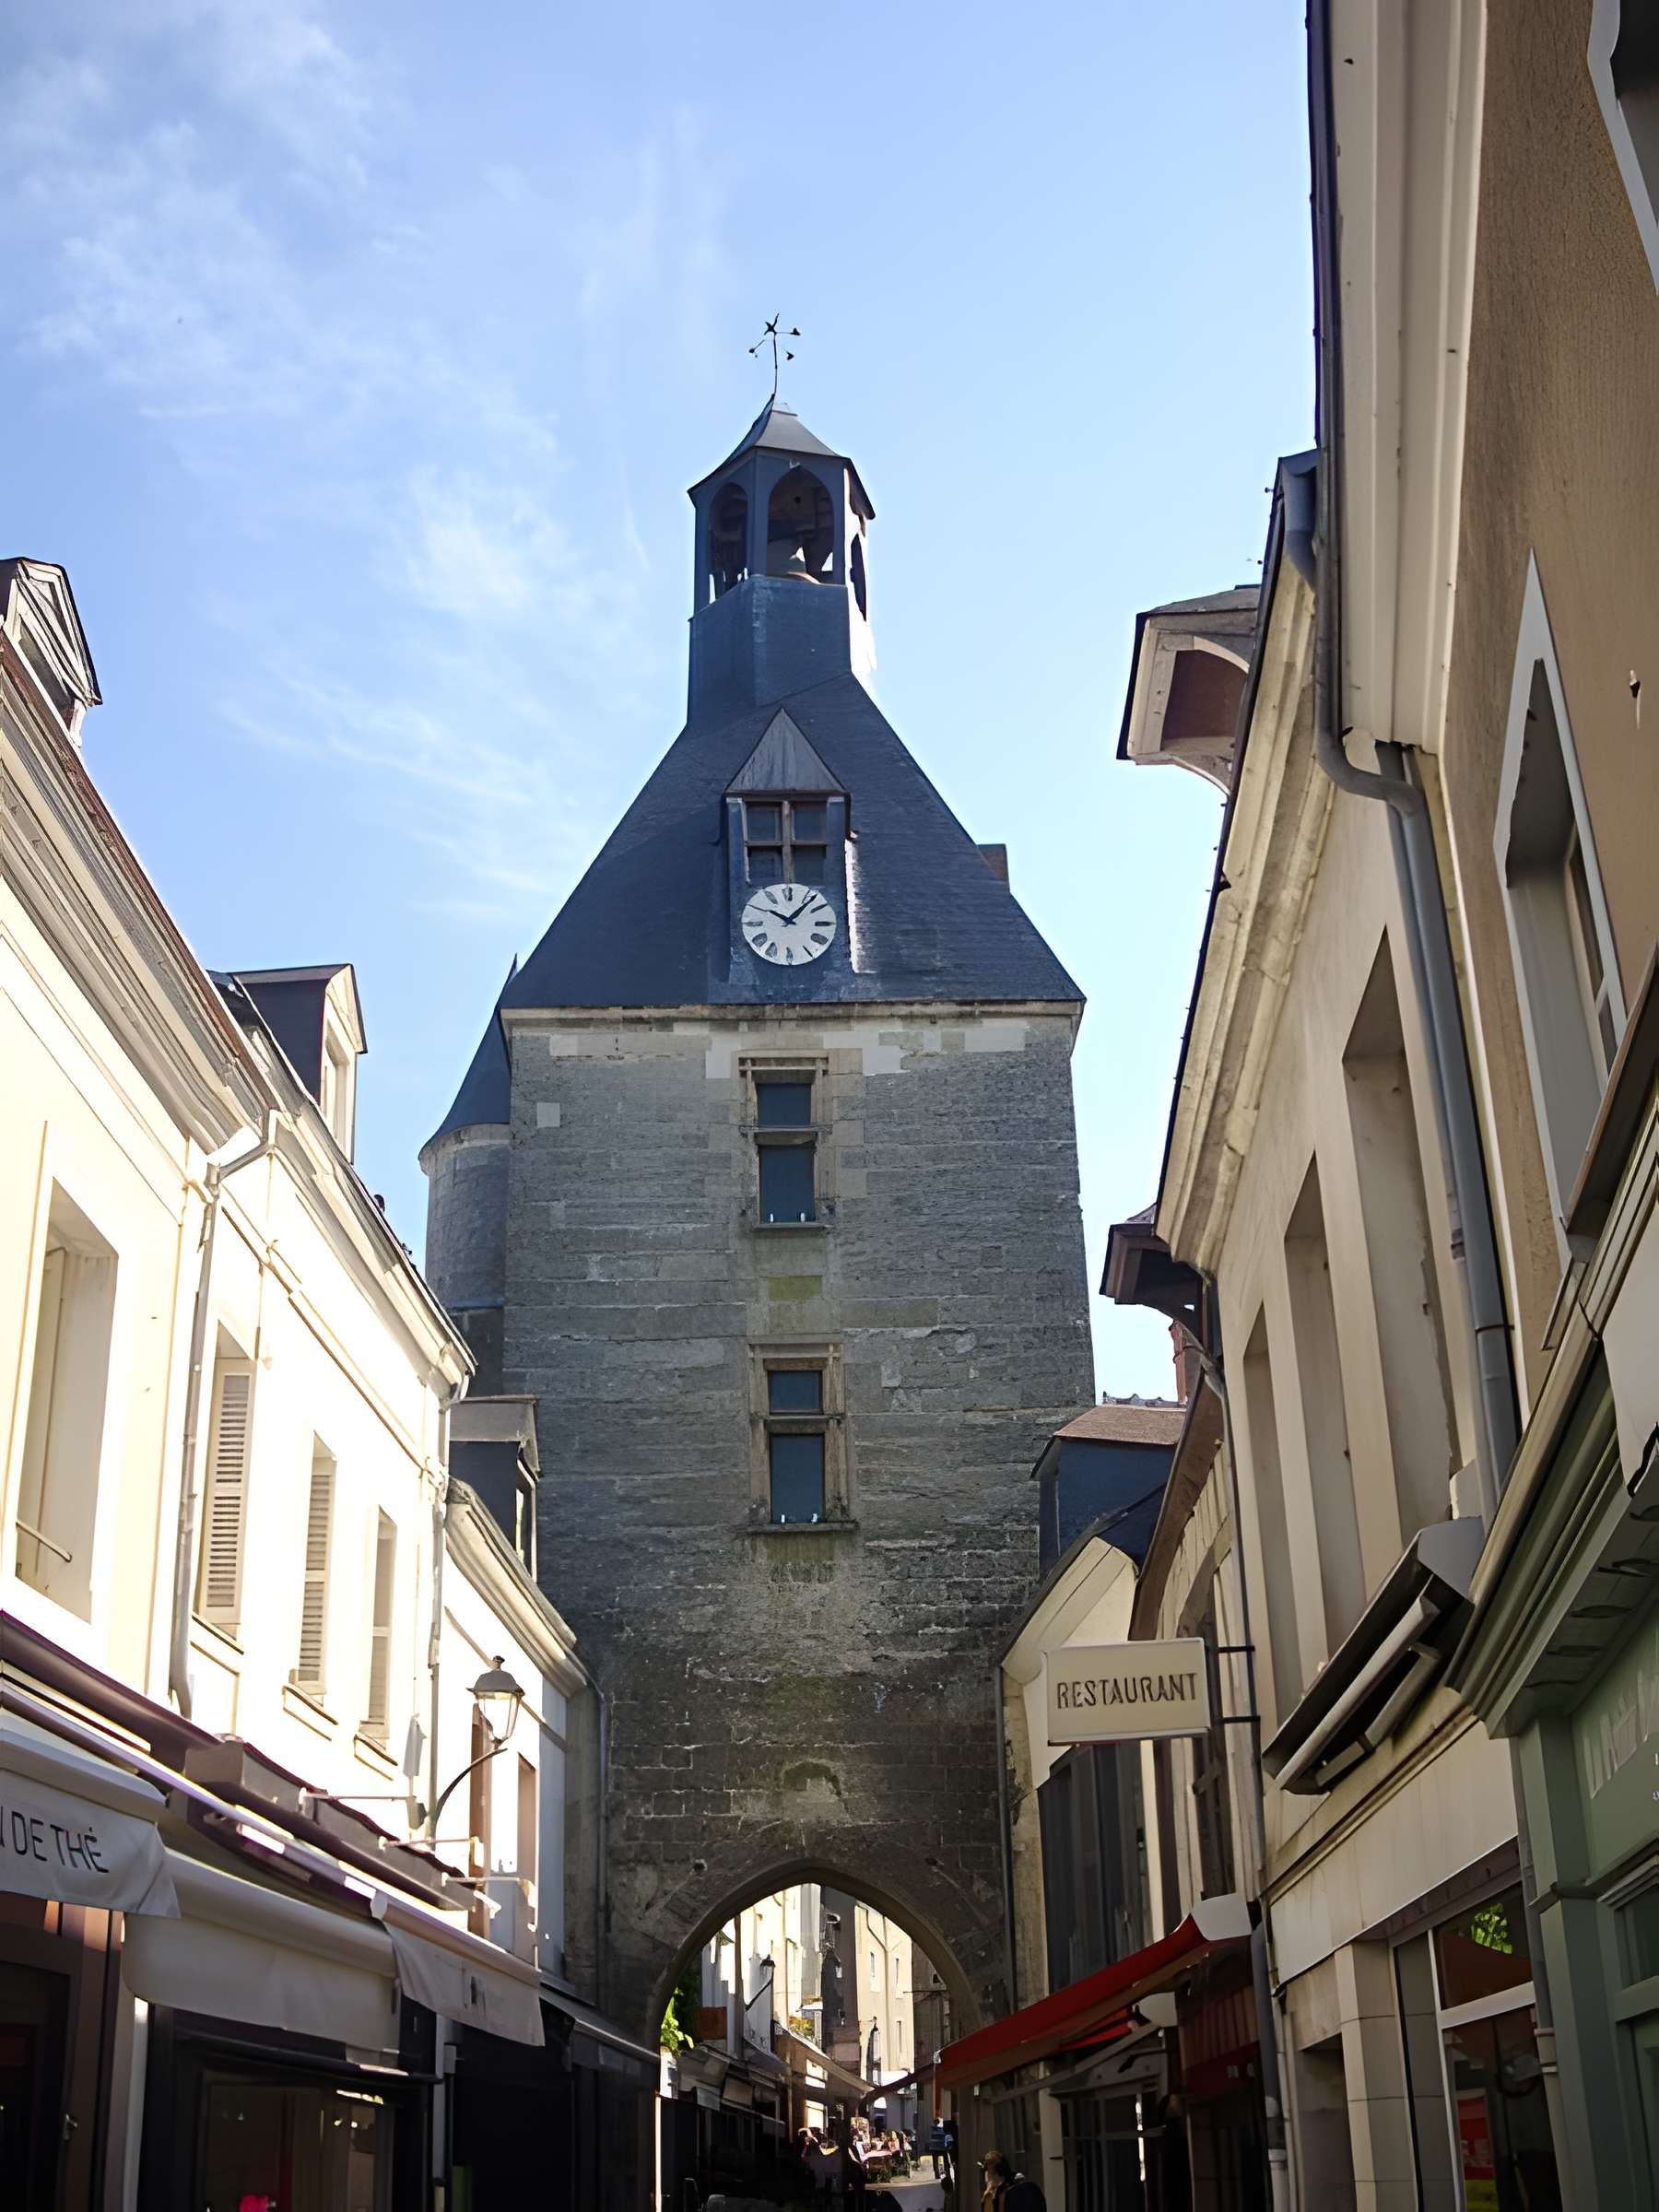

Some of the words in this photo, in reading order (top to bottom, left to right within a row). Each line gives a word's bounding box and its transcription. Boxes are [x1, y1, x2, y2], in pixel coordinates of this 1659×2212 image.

[1057, 1673, 1197, 1710] RESTAURANT
[11, 1810, 47, 1862] DE
[50, 1824, 109, 1873] THÉ
